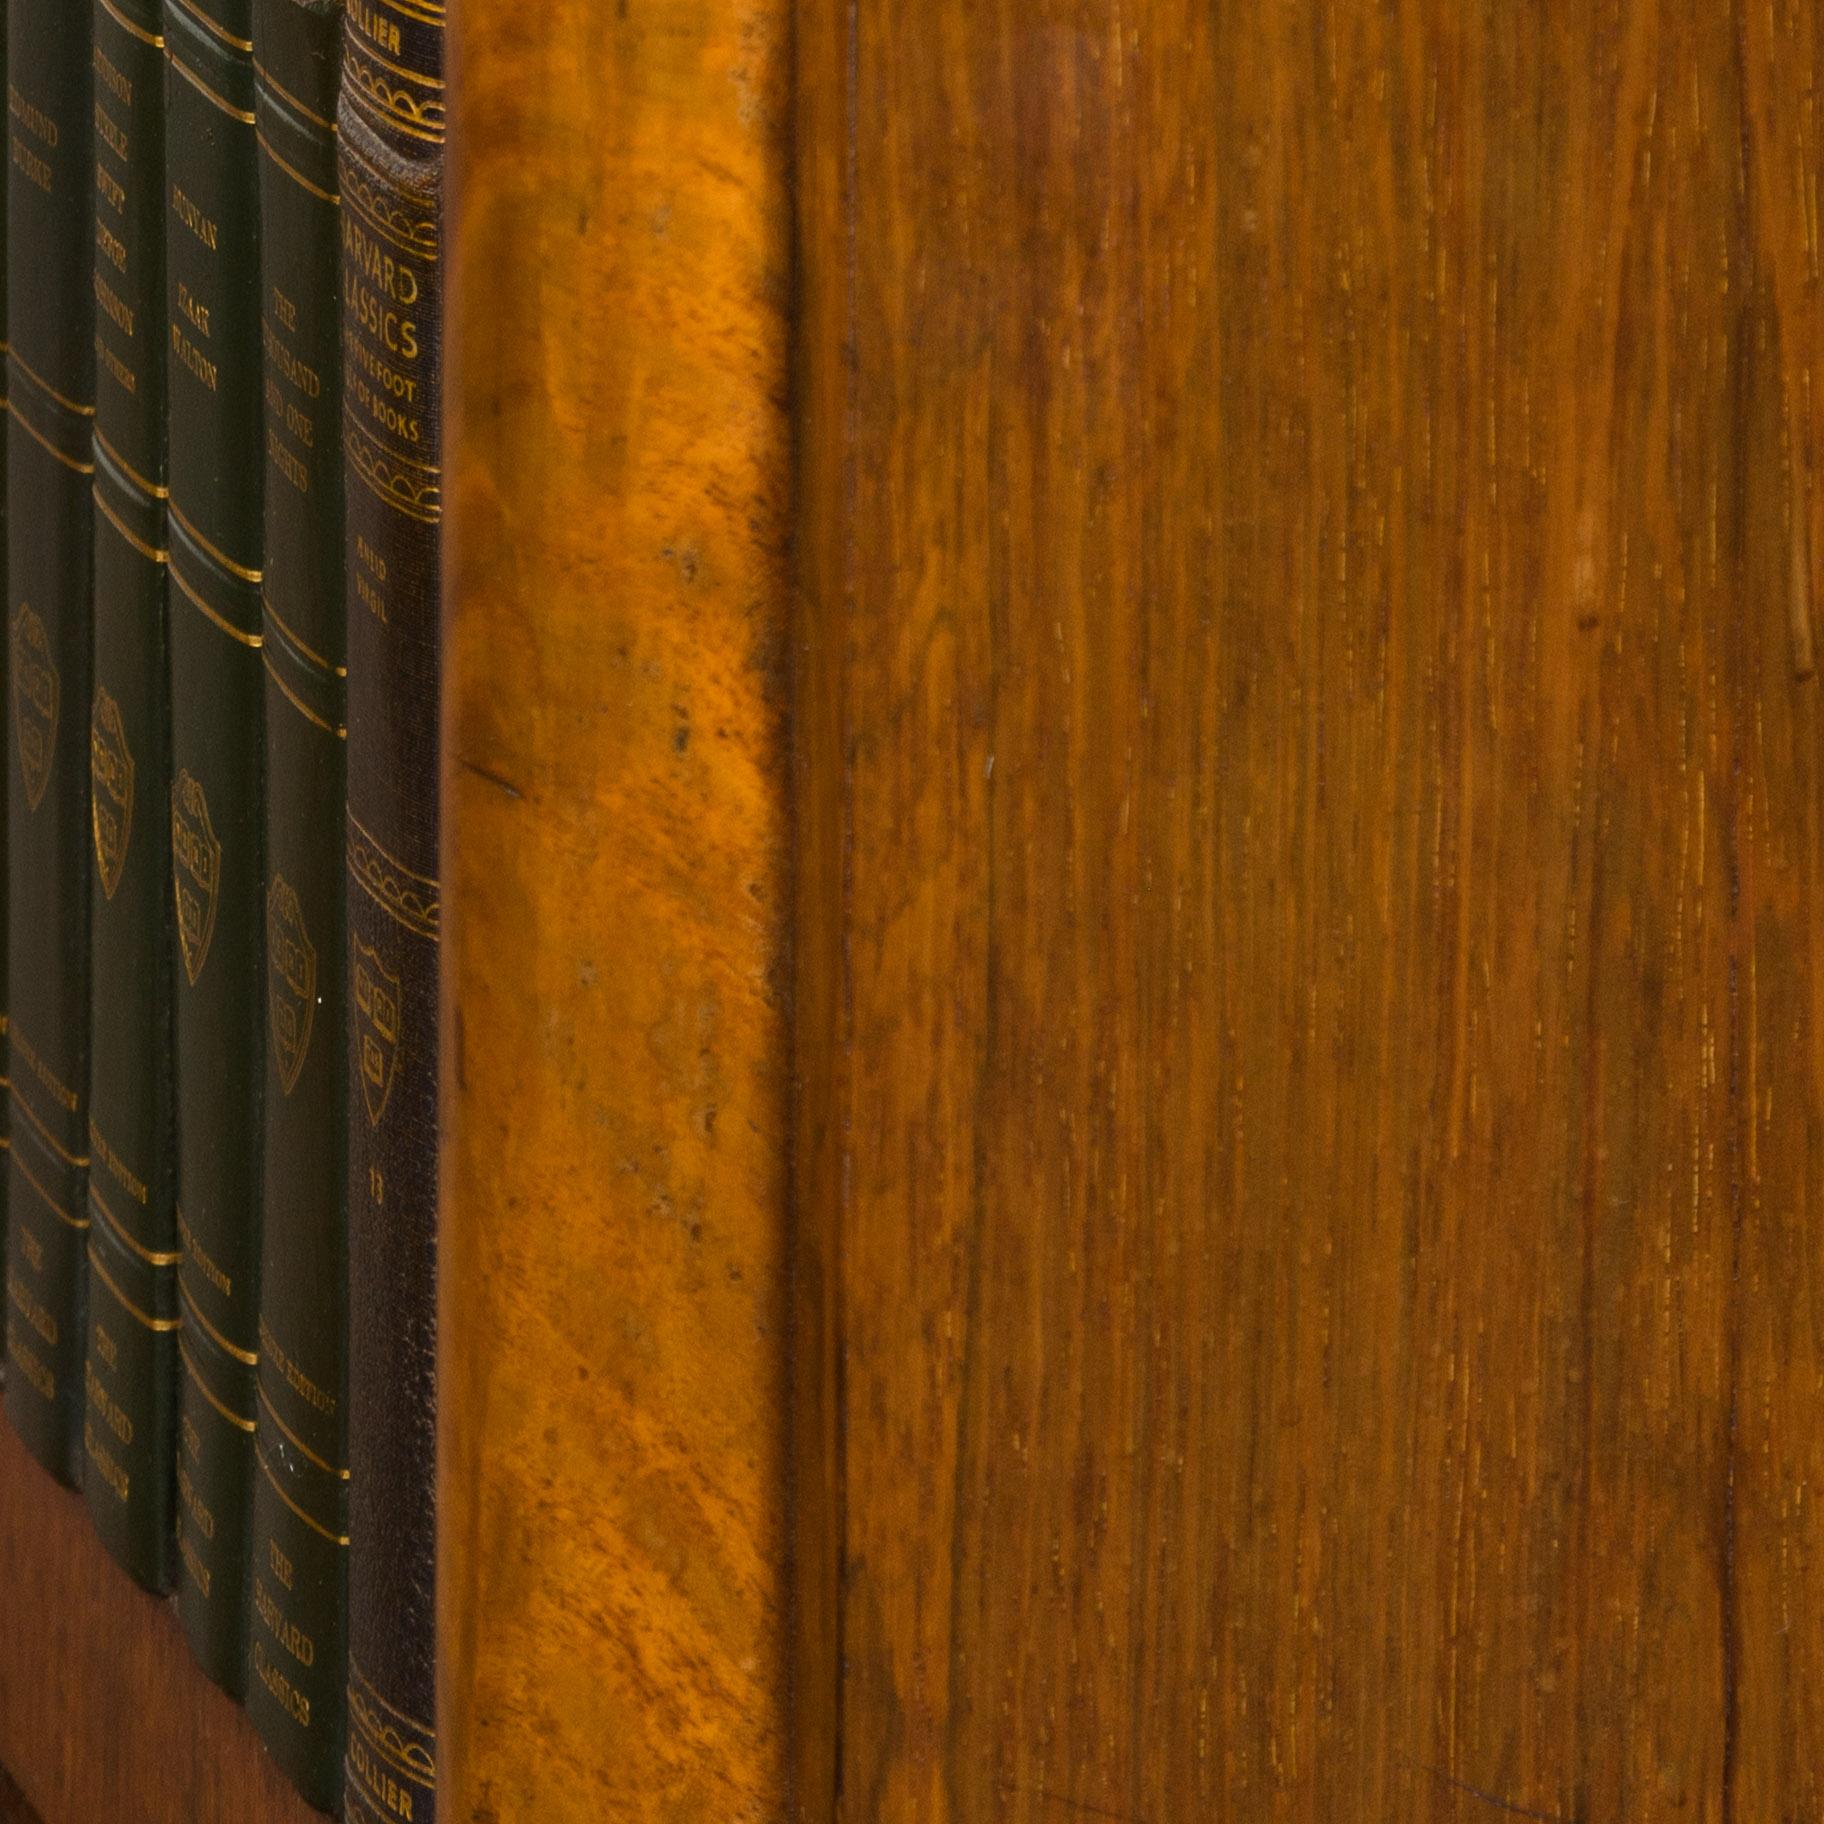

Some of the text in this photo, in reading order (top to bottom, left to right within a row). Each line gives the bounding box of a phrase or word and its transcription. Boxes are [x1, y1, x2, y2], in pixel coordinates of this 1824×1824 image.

[172, 182, 218, 251] BUNYAN
[343, 264, 419, 359] LASSICS
[172, 321, 218, 392] WALTON
[369, 1166, 384, 1205] 13
[269, 1537, 294, 1592] THE
[254, 1576, 314, 1667] HARVARD
[349, 1730, 413, 1822] COLLIER
